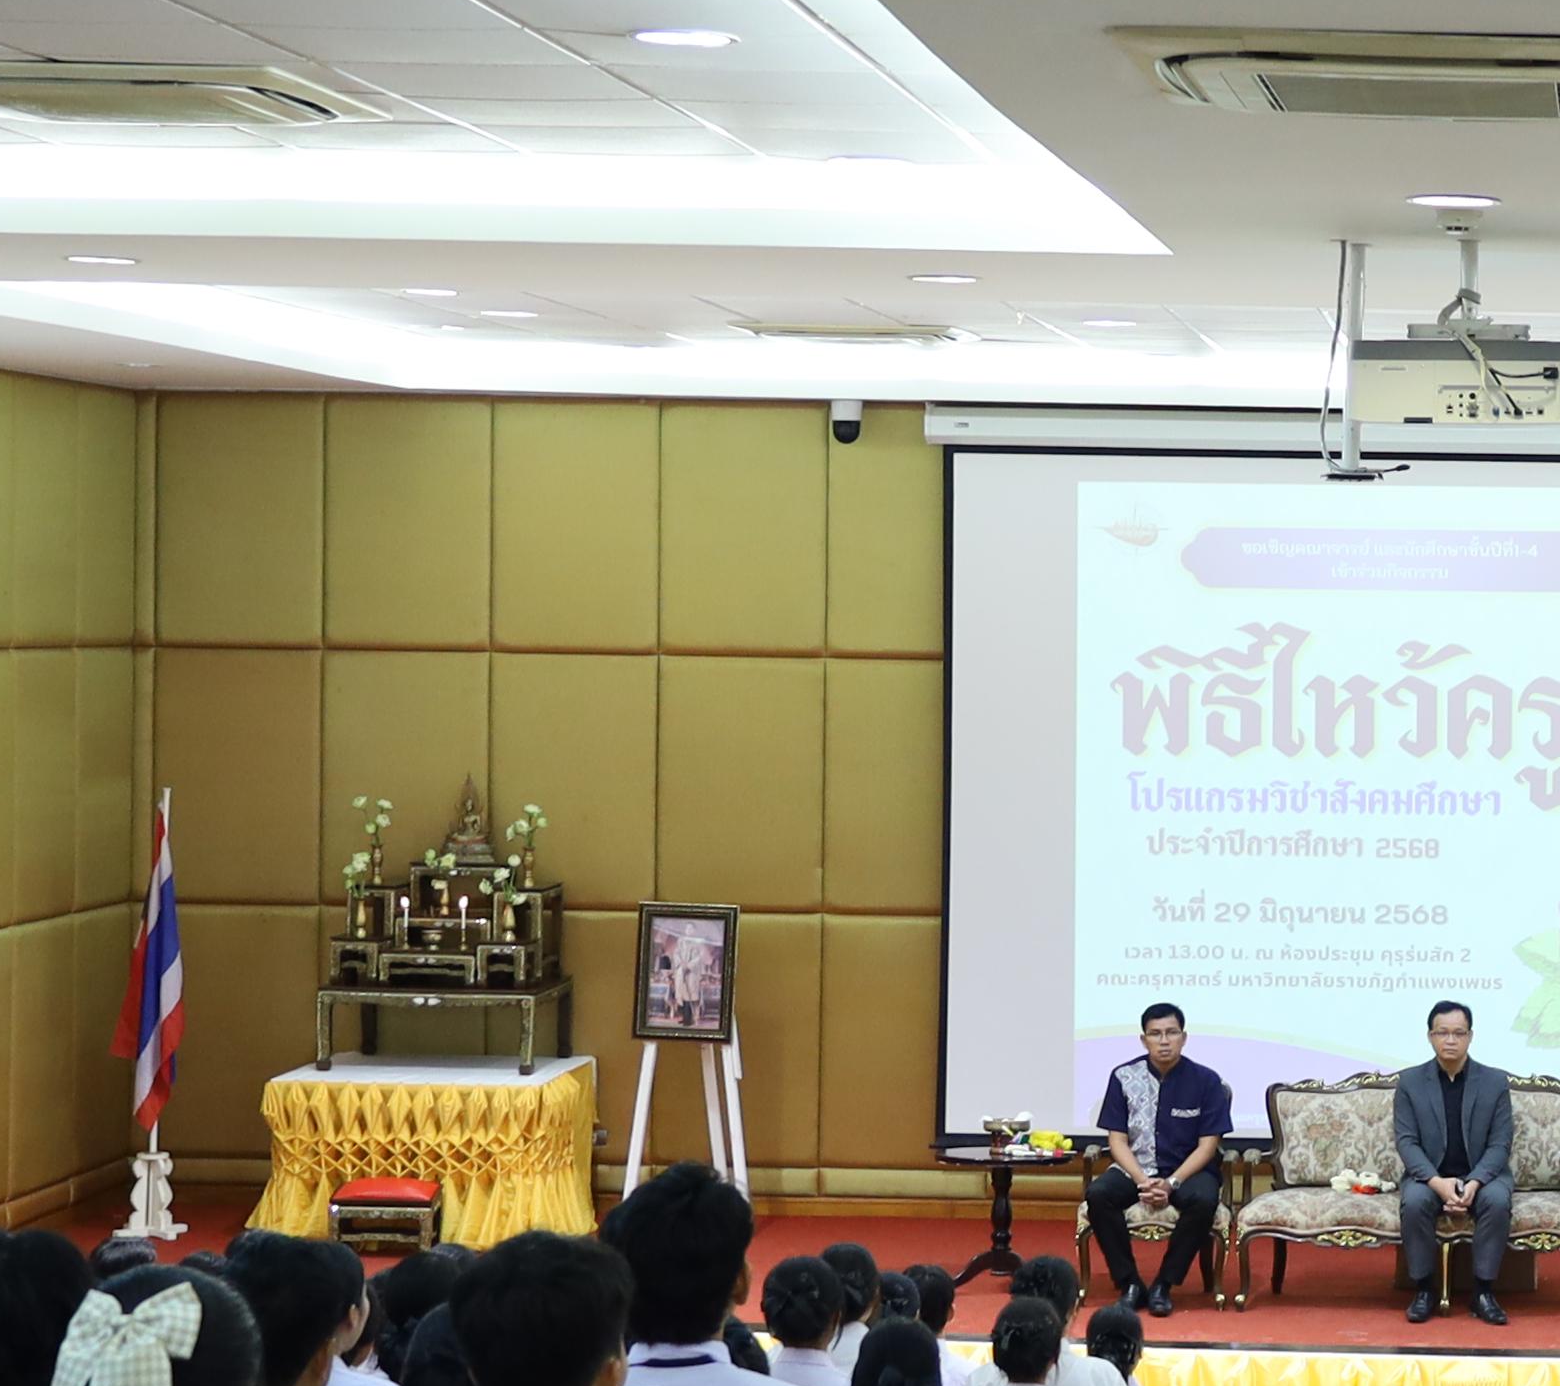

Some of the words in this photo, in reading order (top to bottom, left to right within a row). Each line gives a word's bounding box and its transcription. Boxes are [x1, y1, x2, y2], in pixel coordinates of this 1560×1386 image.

[1127, 771, 1502, 816] โปรแกรมวิชาสังคมศึกษา
[1146, 826, 1363, 859] ประจำปีการศึกษา
[1375, 837, 1440, 860] 2568
[1151, 888, 1206, 924] วันที่
[1213, 902, 1251, 924] 29
[1259, 898, 1366, 932] มิถุนายน
[1374, 904, 1449, 926] 2568
[1124, 945, 1163, 960] เวลา
[1167, 944, 1225, 960] 13.00
[1230, 946, 1250, 960] น.
[1255, 947, 1275, 960] ณ
[1280, 943, 1375, 967] ห้องประชุม
[1460, 947, 1472, 963] 2
[1097, 969, 1223, 991] คณะครุศาสตร์
[1228, 970, 1504, 993] มหาวิทยาลัยราชภัฏกำแพงเพชร
